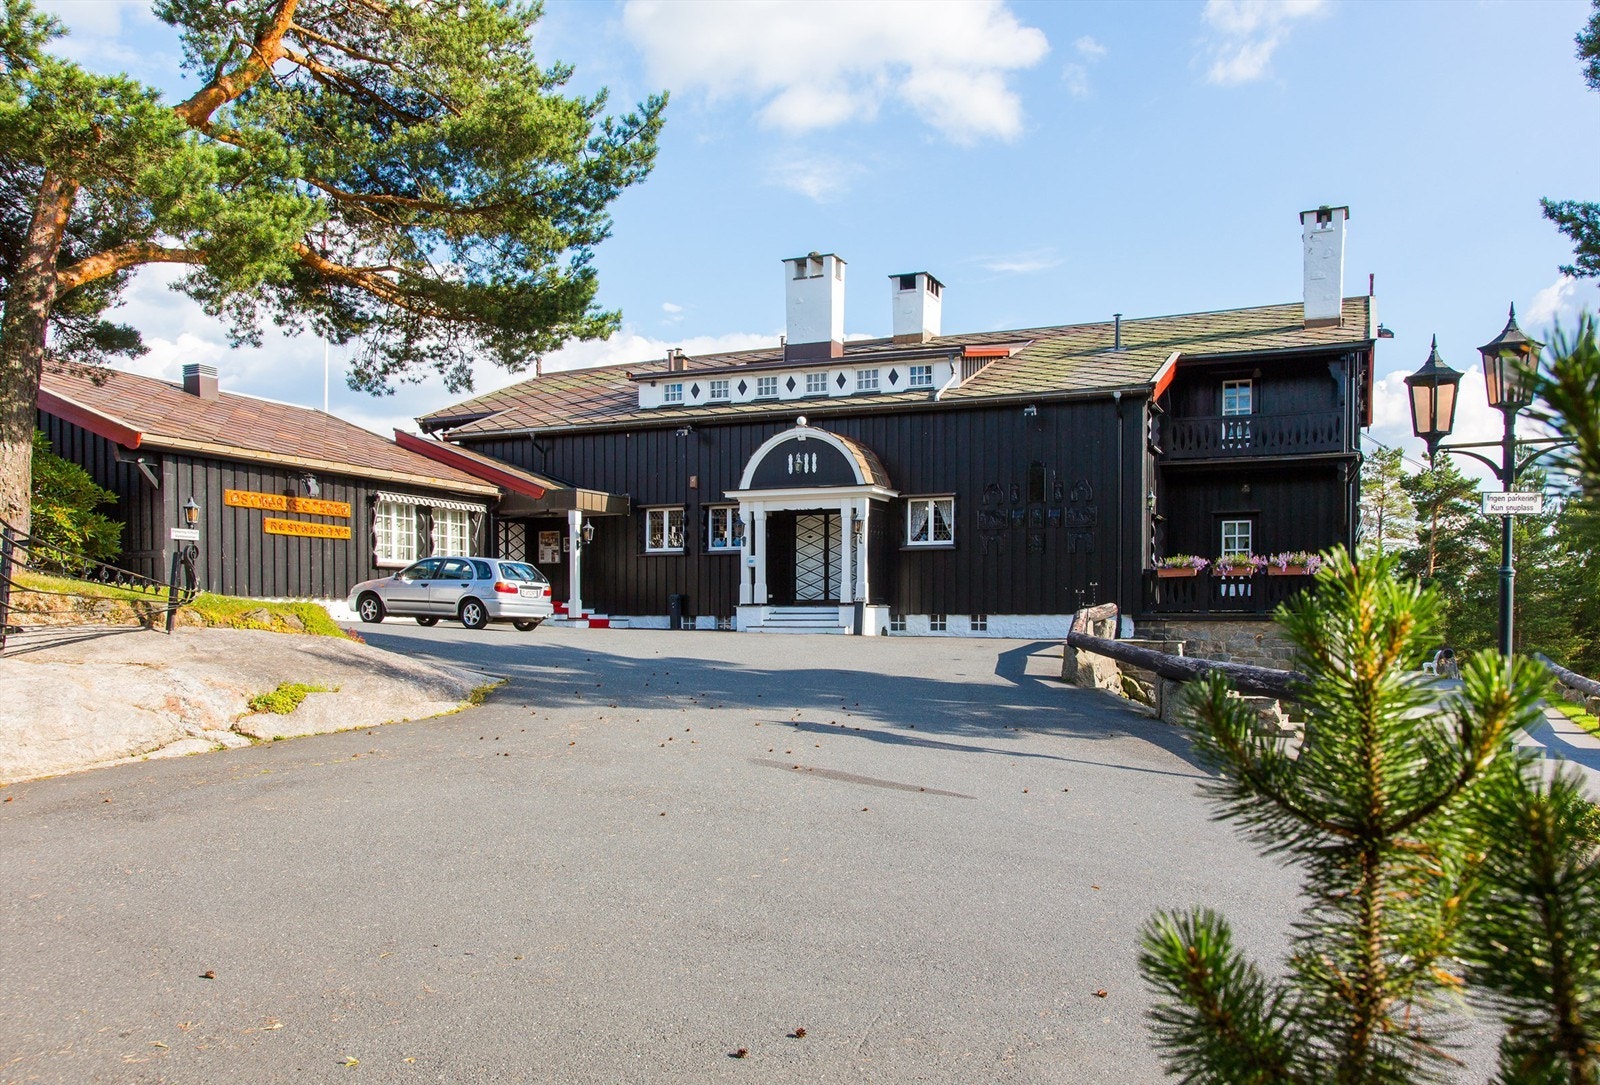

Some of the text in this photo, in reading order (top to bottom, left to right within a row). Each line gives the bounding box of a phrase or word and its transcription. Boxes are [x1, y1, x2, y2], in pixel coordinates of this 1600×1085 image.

[1486, 494, 1538, 503] Ingen parkering
[1505, 504, 1534, 512] snuplass
